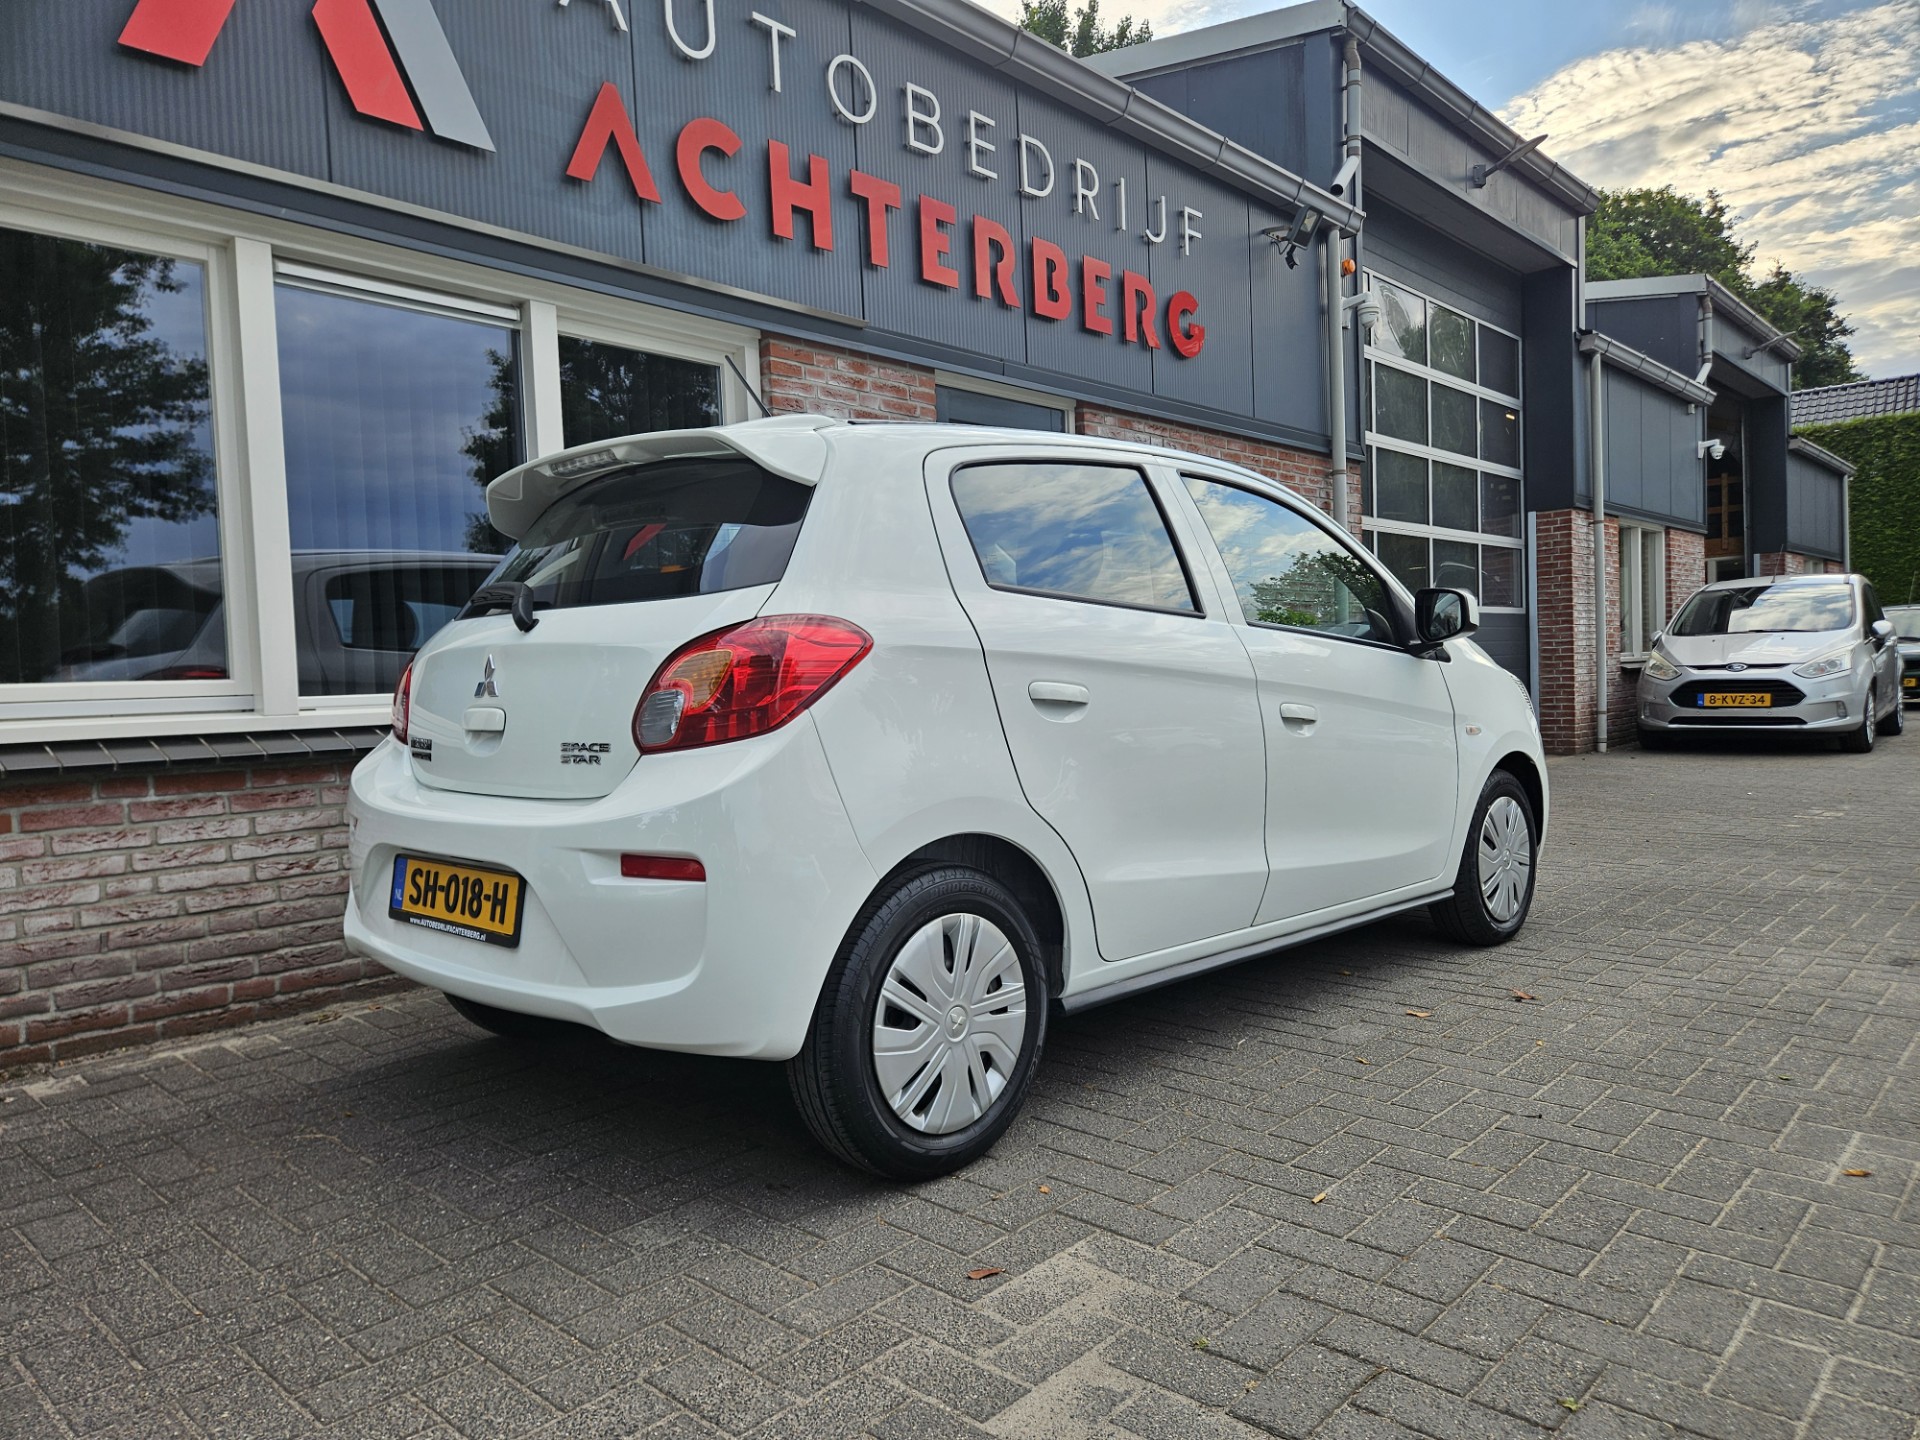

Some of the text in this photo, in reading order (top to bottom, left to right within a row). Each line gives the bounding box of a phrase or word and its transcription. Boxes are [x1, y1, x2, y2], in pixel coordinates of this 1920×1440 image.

[566, 81, 1206, 360] ACHTERBERG
[1709, 695, 1765, 705] 8-KVZ-34
[560, 742, 611, 753] SPACE
[560, 754, 602, 766] STAR
[408, 867, 509, 925] SH-018-H
